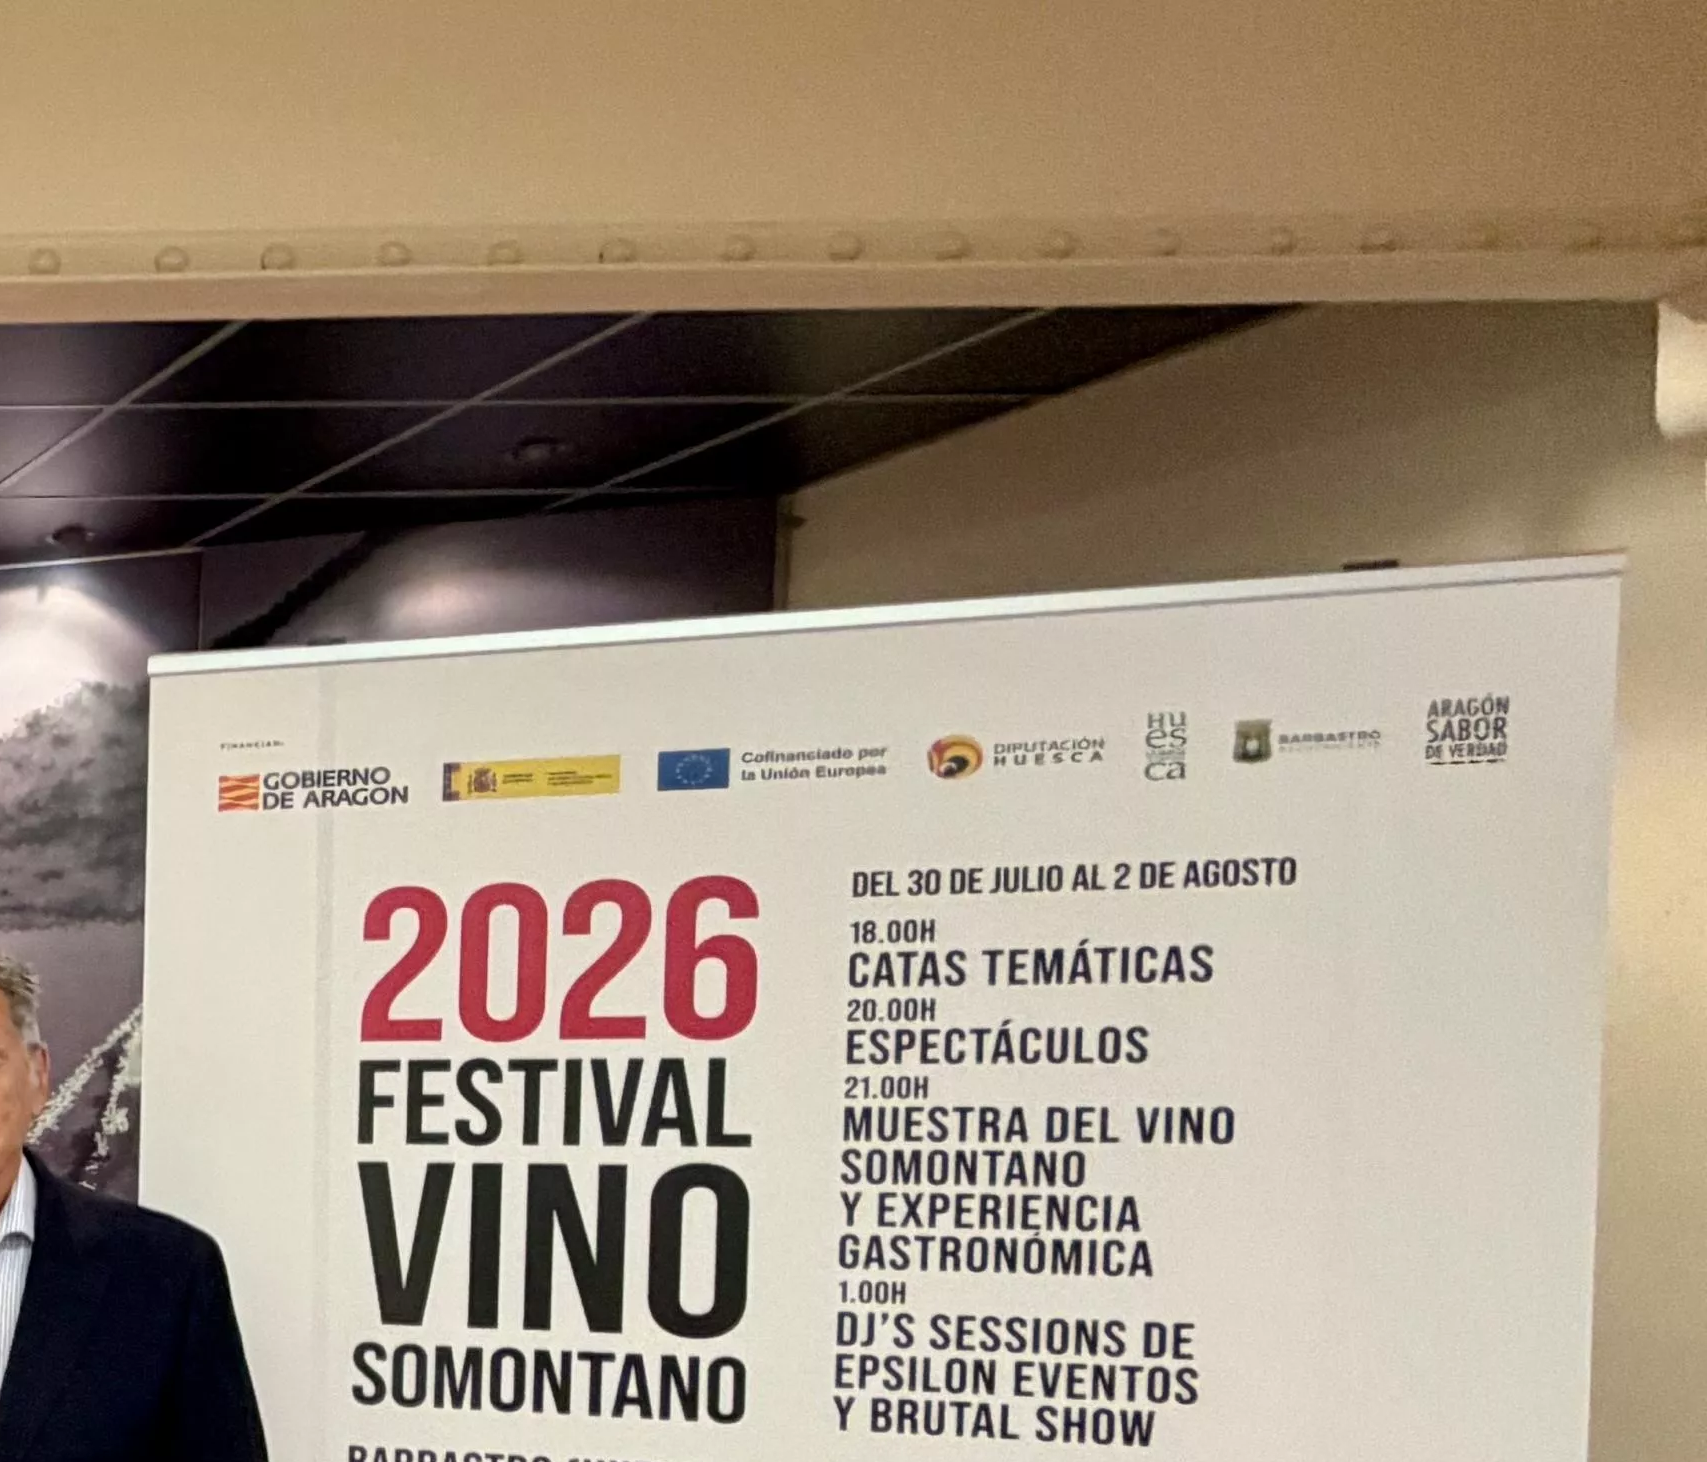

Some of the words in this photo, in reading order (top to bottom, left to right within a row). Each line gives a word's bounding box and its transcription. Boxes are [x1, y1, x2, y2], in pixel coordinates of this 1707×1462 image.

[1427, 693, 1510, 719] ARAGÓN
[994, 736, 1105, 755] DIPUTACIÓN
[1426, 717, 1507, 743] SABOR
[741, 748, 853, 763] Cofinanciado
[858, 746, 888, 761] por
[994, 751, 1103, 766] HUESCA
[1425, 745, 1443, 760] DE
[1448, 743, 1508, 758] VERDAD
[263, 766, 391, 790] GOBIERNO
[741, 770, 756, 781] la
[761, 767, 810, 780] Unión
[815, 765, 886, 779] Europea
[262, 791, 294, 811] DE
[303, 786, 409, 808] ARAGON
[852, 869, 900, 898] DEL
[907, 869, 941, 896] 30
[949, 868, 984, 895] DE
[989, 865, 1063, 894] JULIO
[1072, 864, 1106, 891] AL
[1113, 863, 1131, 890] 2
[1139, 862, 1175, 889] DE
[1182, 856, 1297, 889] AGOSTO
[850, 919, 937, 944] 18.00H
[360, 874, 760, 1043] 2026
[848, 949, 968, 988] CATAS
[982, 938, 1215, 986] TEMÁTICAS
[847, 997, 937, 1022] 20.00H
[846, 1017, 1149, 1065] ESPECTÁCULOS
[357, 1056, 753, 1148] FESTIVAL
[844, 1075, 929, 1100] 21.00H
[842, 1106, 1029, 1143] MUESTRA
[1046, 1106, 1120, 1144] DEL
[1137, 1106, 1235, 1145] VINO
[840, 1147, 1087, 1188] SOMONTANO
[840, 1192, 862, 1227] Y
[877, 1192, 1141, 1232] EXPERIENCIA
[357, 1161, 752, 1339] VINO
[838, 1232, 1153, 1277] GASTRONÓMICA
[838, 1280, 907, 1305] 1.00H
[836, 1312, 916, 1348] DJ'S
[929, 1314, 1127, 1358] SESSIONS
[1143, 1322, 1195, 1360] DE
[350, 1342, 747, 1425] SOMONTANO
[835, 1354, 997, 1396] EPSILON
[1013, 1360, 1199, 1405] EVENTOS
[833, 1396, 856, 1431] Y
[870, 1398, 1020, 1440] BRUTAL
[1035, 1407, 1156, 1447] SHOW
